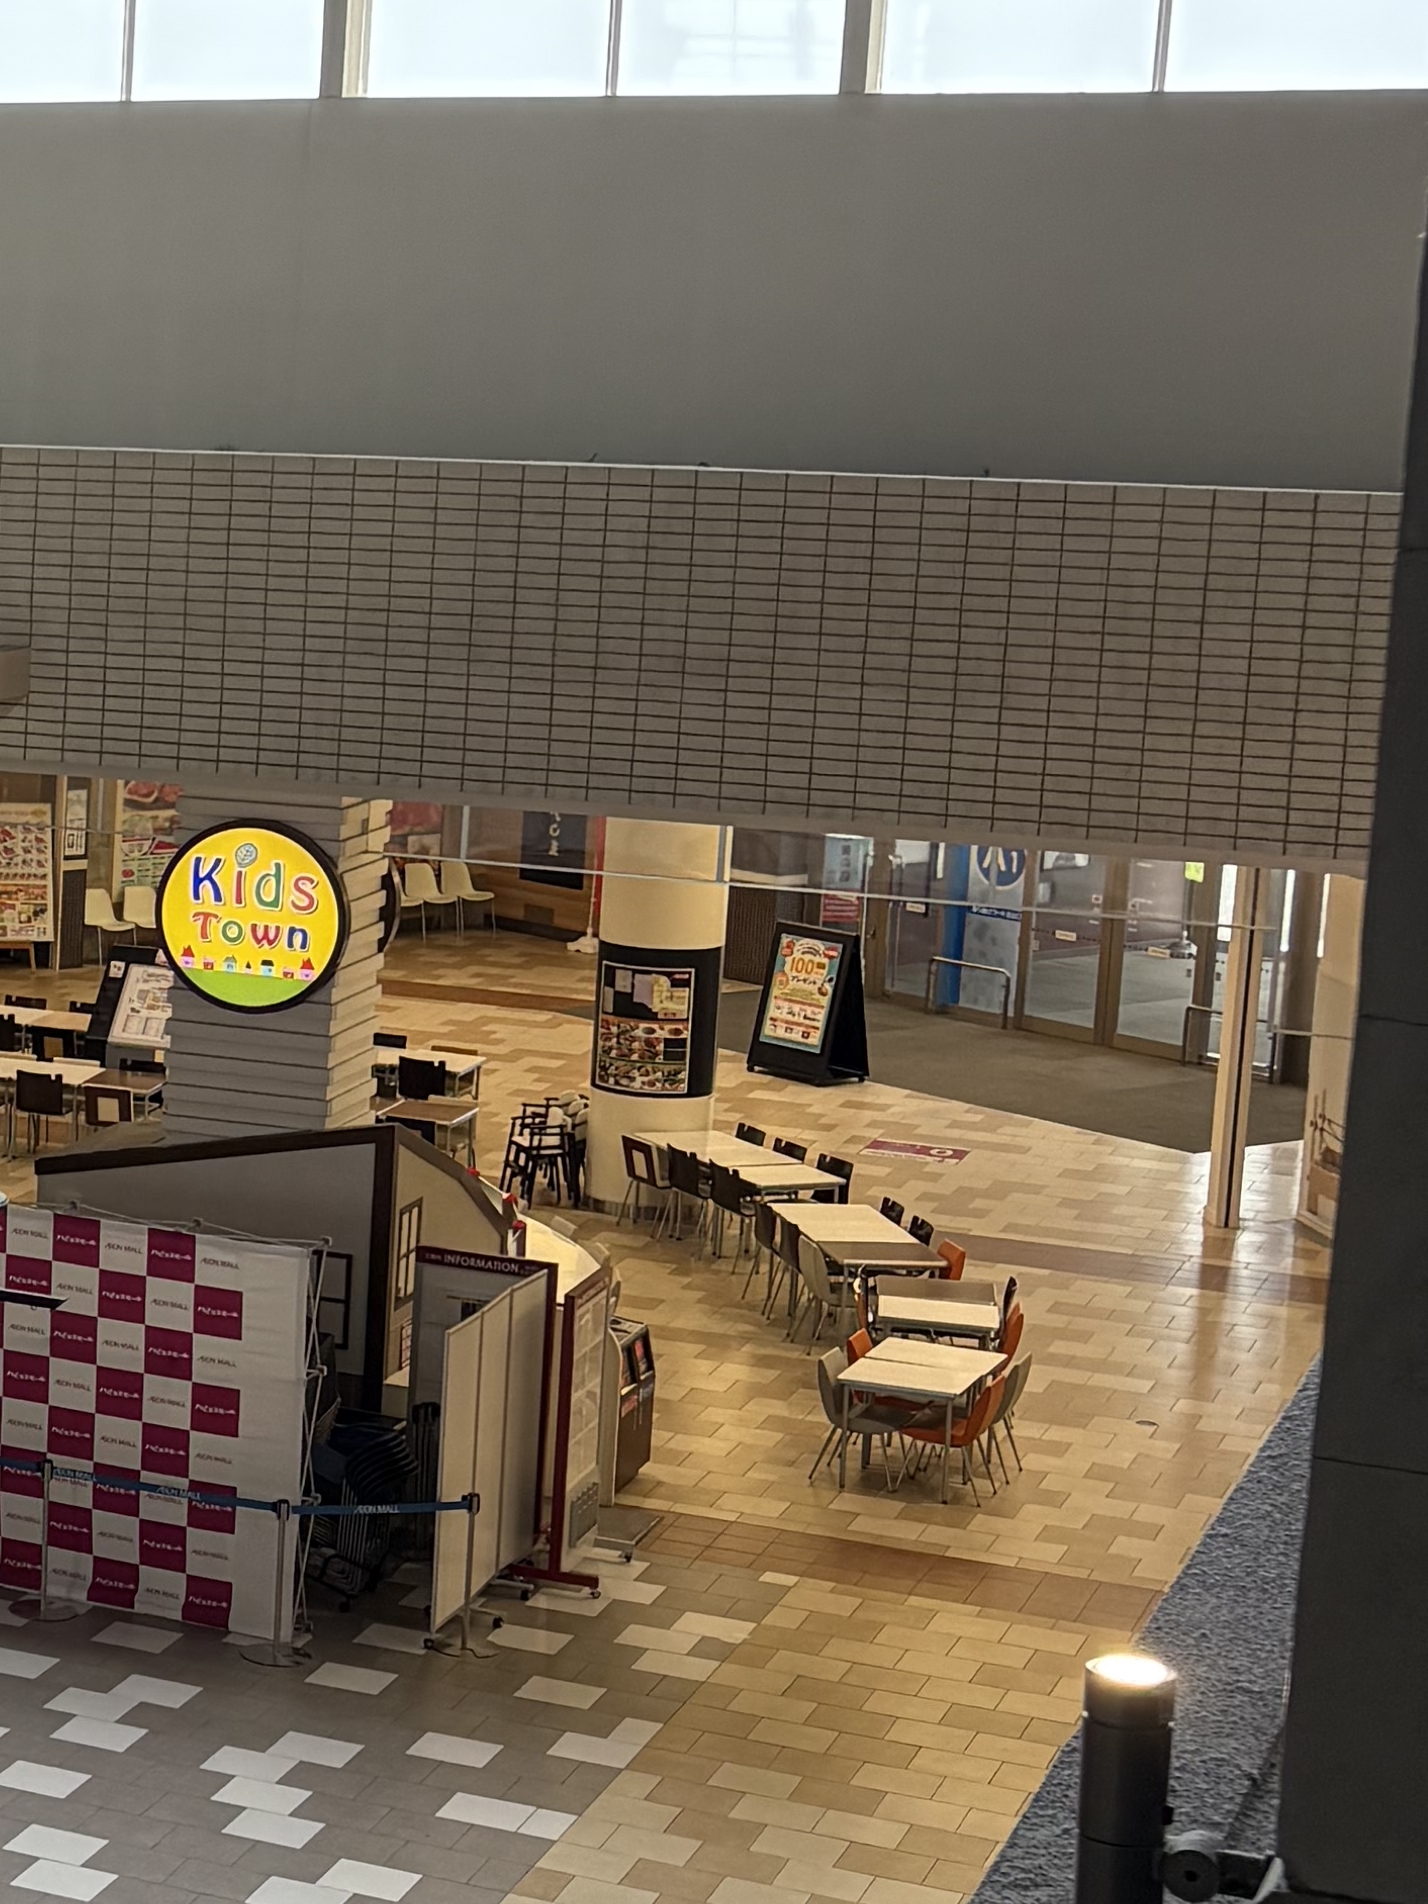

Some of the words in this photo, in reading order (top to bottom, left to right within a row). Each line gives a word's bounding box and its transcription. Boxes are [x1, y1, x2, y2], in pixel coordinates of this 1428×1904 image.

[192, 844, 318, 913] Kids
[192, 911, 309, 950] Town
[443, 1253, 519, 1274] INFORMATION
